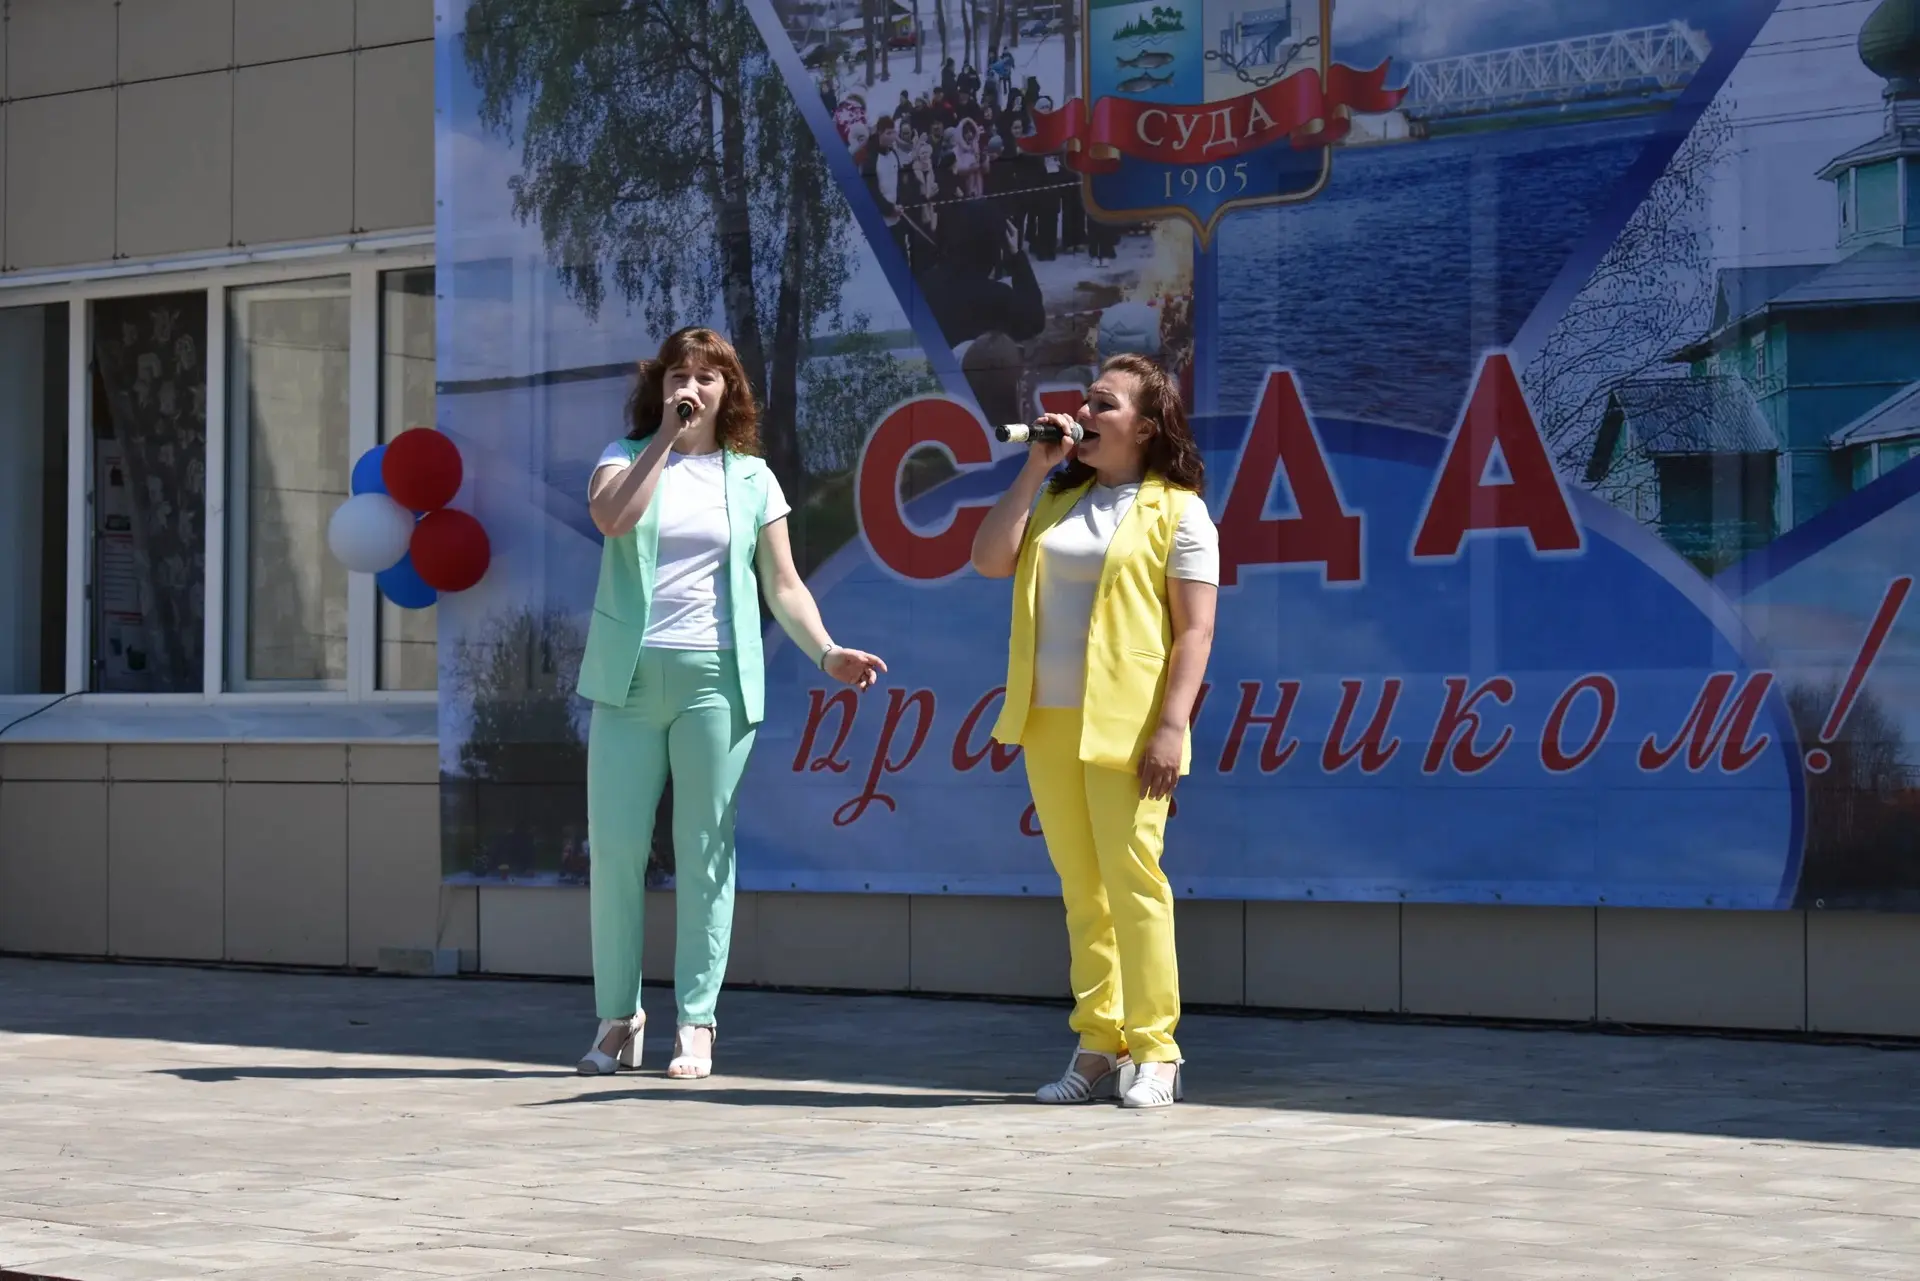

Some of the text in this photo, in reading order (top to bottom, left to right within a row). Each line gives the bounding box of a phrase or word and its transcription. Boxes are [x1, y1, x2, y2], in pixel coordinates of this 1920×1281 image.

[1137, 98, 1278, 154] СУДА
[1163, 162, 1249, 198] 1905
[859, 352, 1582, 587] СДА
[792, 577, 1911, 836] праником!
